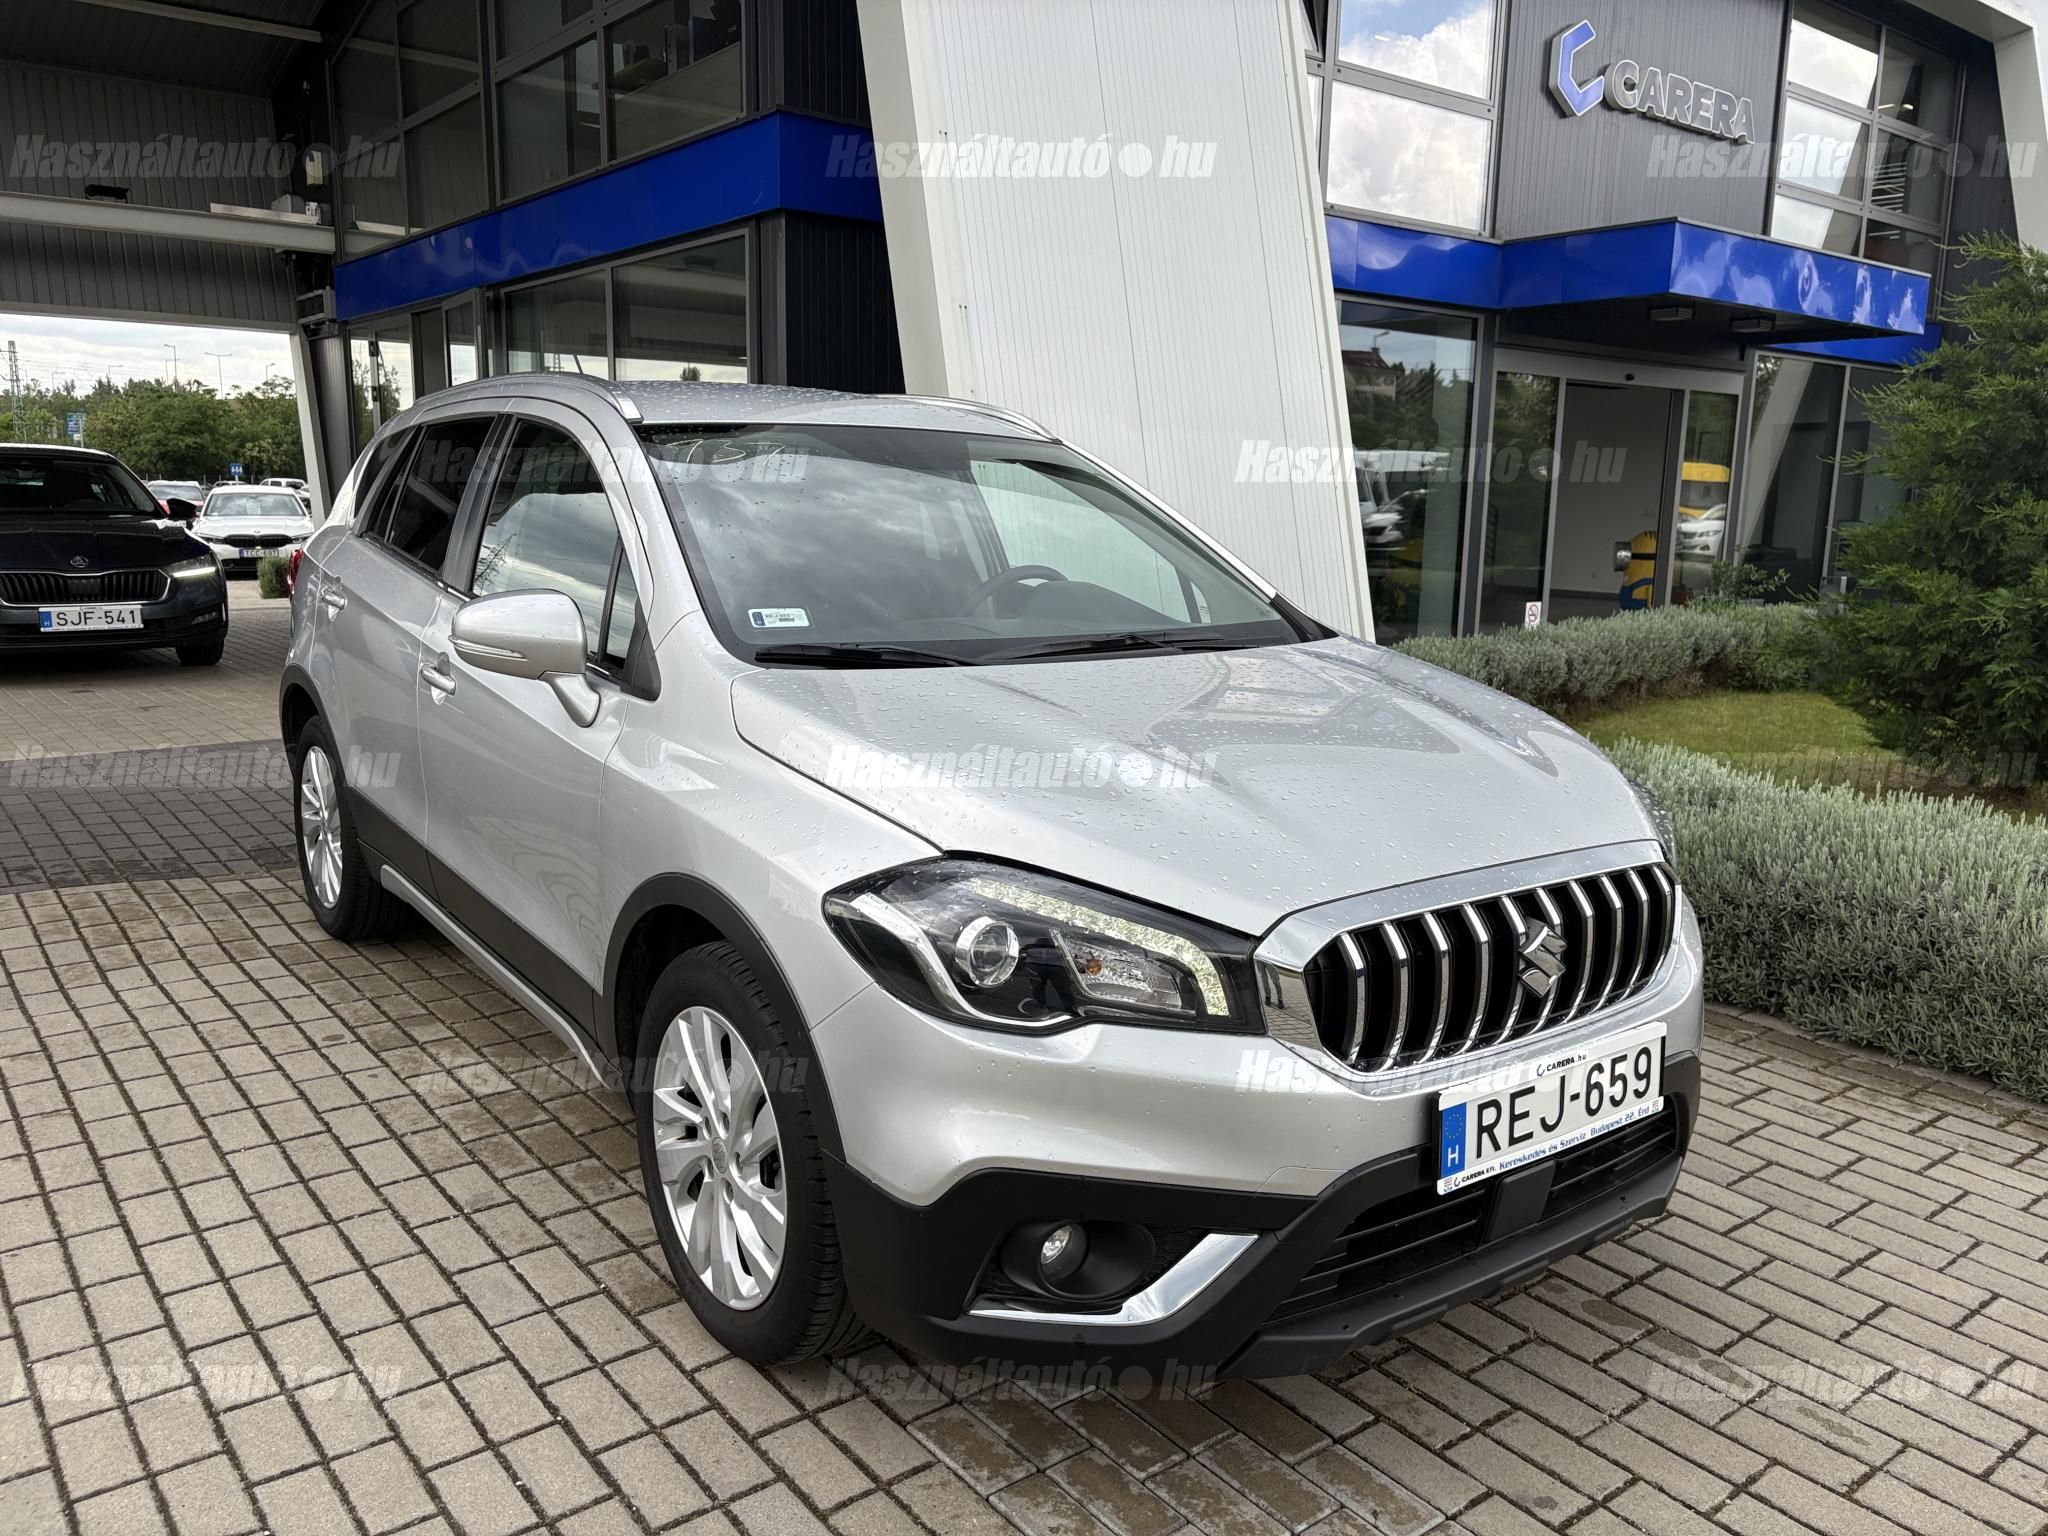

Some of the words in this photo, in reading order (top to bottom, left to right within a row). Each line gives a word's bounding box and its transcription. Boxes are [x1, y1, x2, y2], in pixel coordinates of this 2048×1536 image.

[1606, 59, 1755, 145] CARERA
[56, 610, 136, 626] SJF-541
[1447, 1144, 1459, 1168] H
[1476, 1046, 1652, 1159] REJ-659
[1590, 1118, 1623, 1137] Budapest
